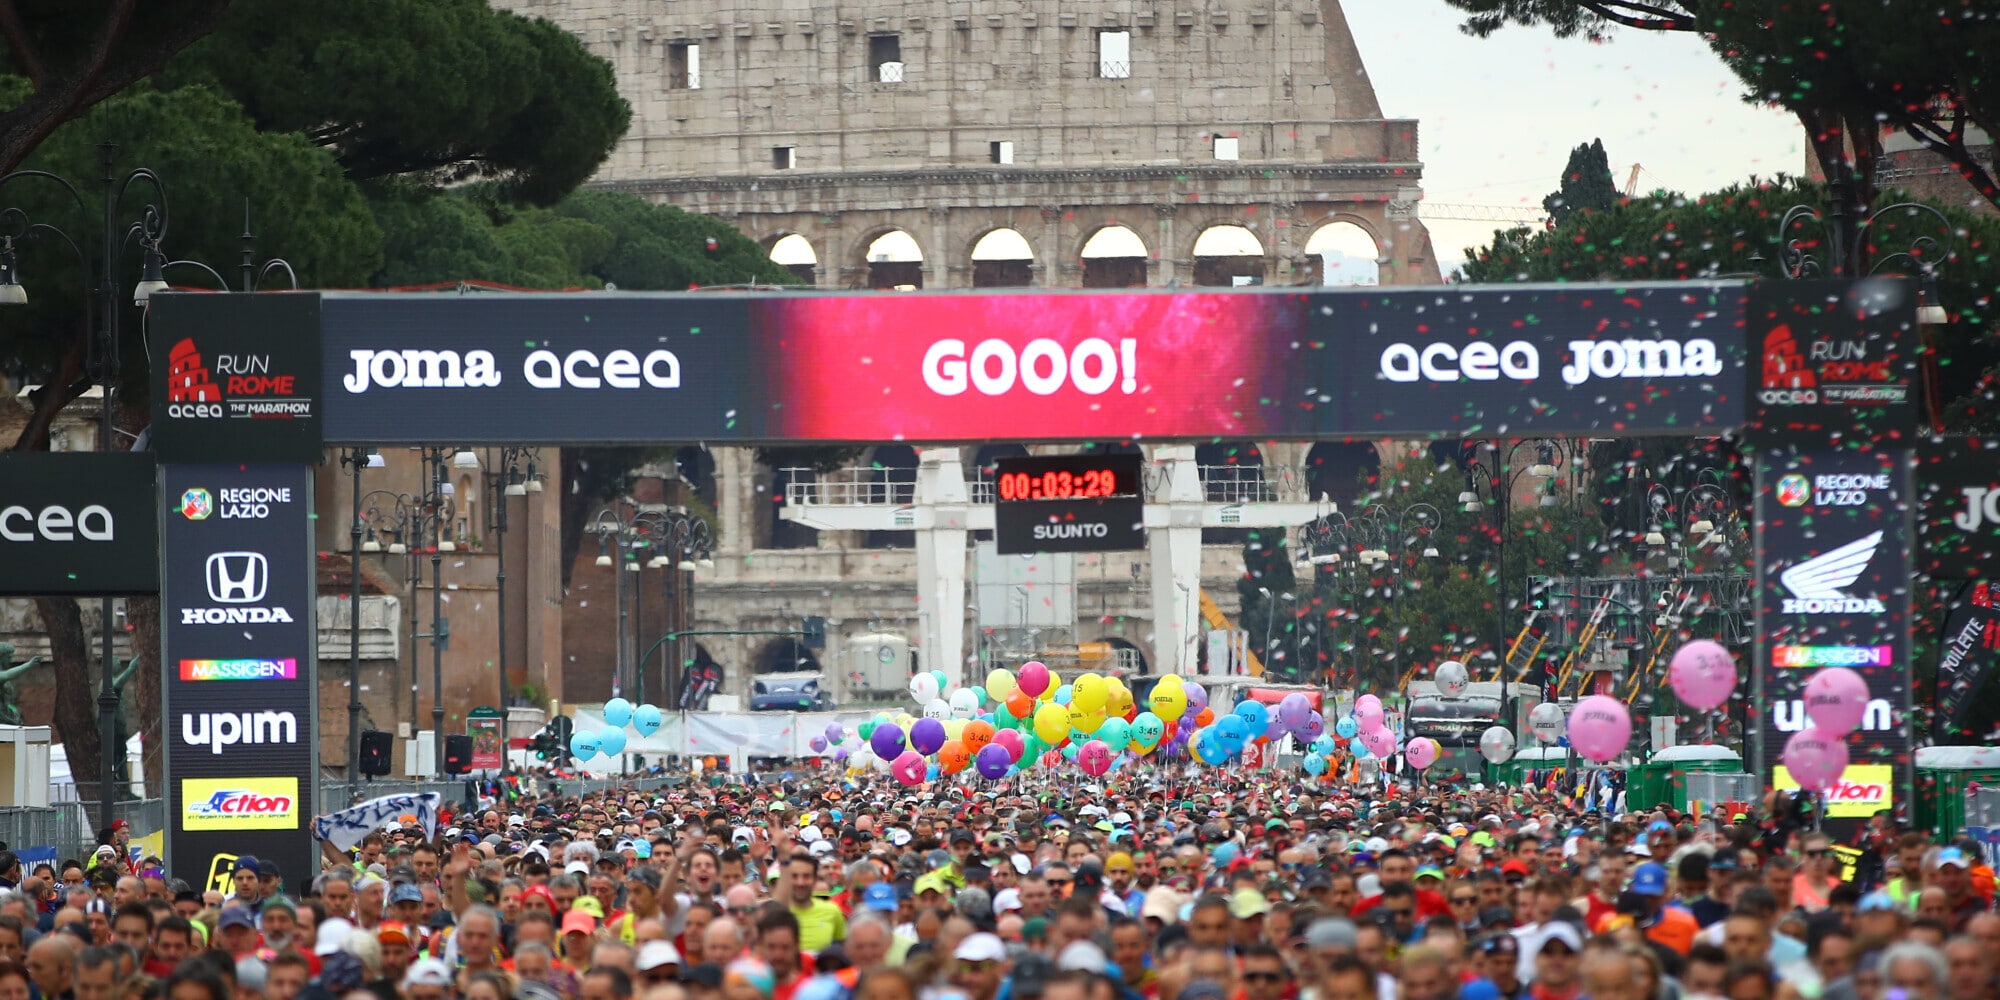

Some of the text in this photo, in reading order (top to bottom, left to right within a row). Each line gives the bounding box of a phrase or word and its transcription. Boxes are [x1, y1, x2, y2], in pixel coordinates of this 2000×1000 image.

[1810, 341, 1867, 360] RUN
[216, 354, 269, 374] RUN
[523, 350, 680, 388] acea
[922, 338, 1137, 395] GOOO!
[1381, 341, 1539, 382] acea
[1821, 362, 1890, 381] ROME
[227, 375, 295, 395] ROME
[168, 404, 223, 418] acea
[248, 403, 310, 413] MARATHON
[1001, 469, 1116, 500] 00:03:29
[1815, 475, 1890, 491] REGIONE
[220, 488, 291, 504] REGIONE
[1815, 491, 1867, 506] LAZIO
[220, 504, 270, 519] LAZIO
[1033, 523, 1108, 539] SUUNTO
[1781, 599, 1886, 614] HONDA
[181, 608, 294, 624] HONDA
[1940, 617, 1985, 672] TOILETTE
[191, 661, 285, 677] MASSIGEN
[182, 711, 297, 754] upim
[1139, 726, 1158, 736] 3:45
